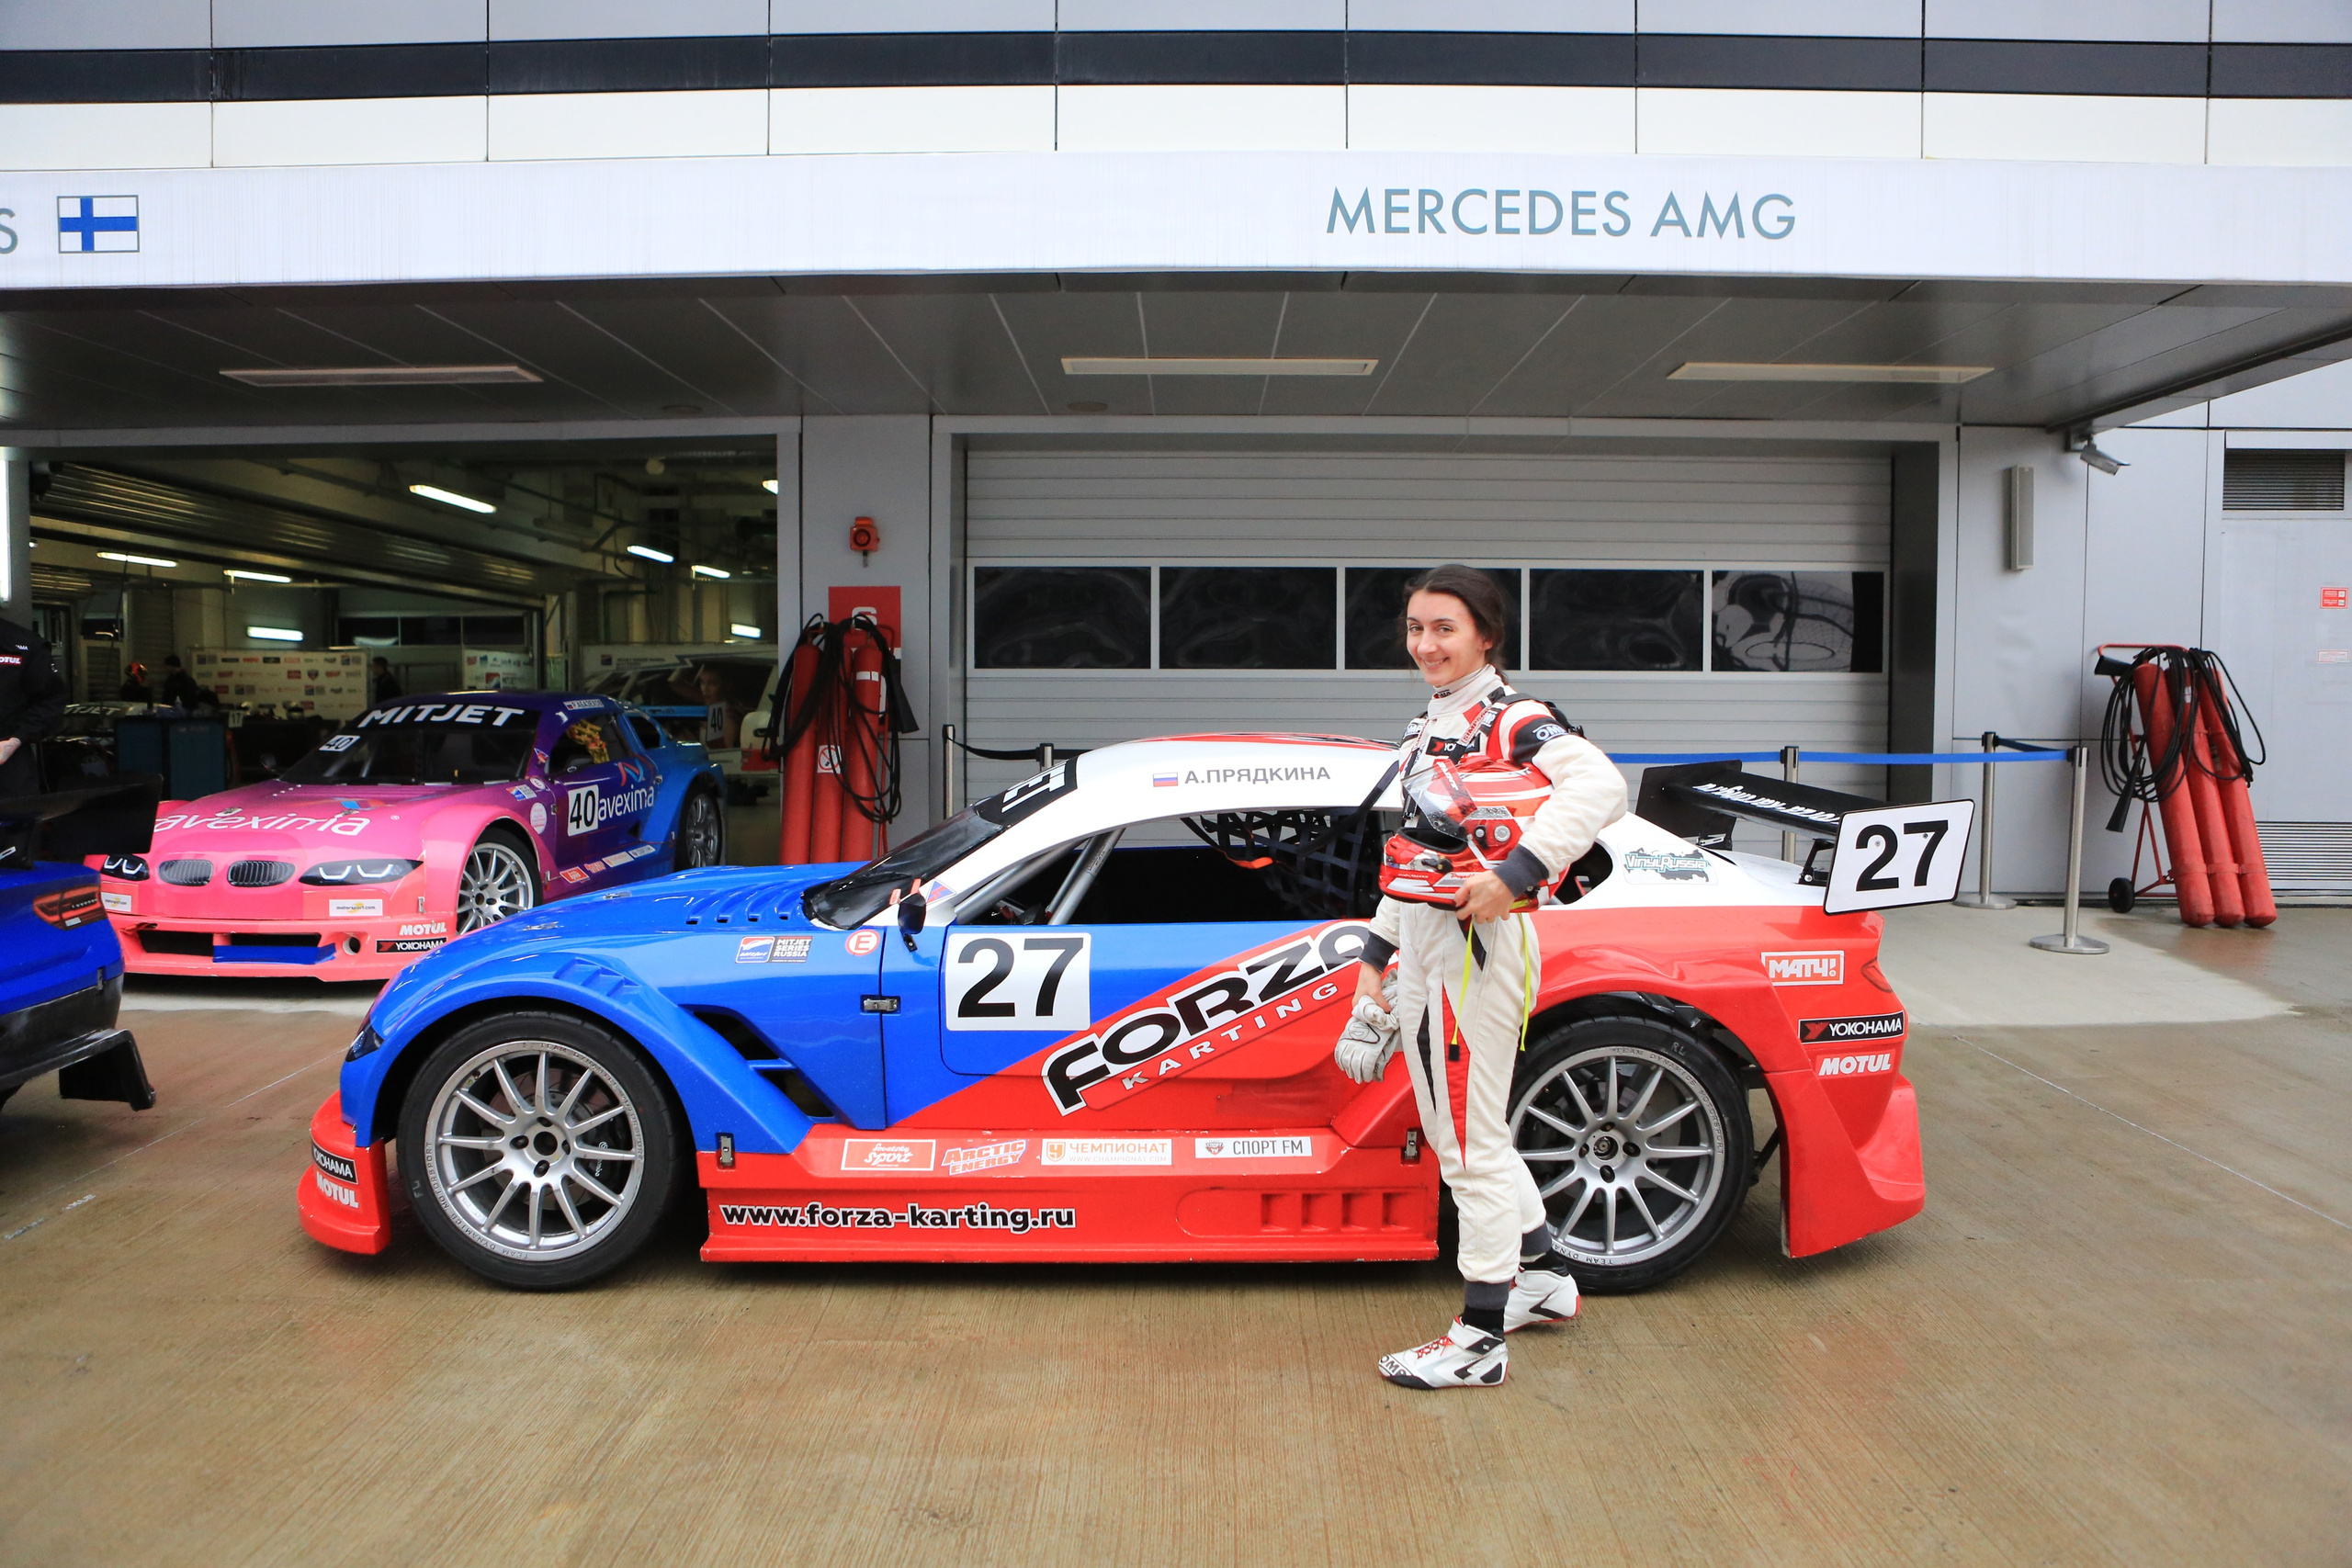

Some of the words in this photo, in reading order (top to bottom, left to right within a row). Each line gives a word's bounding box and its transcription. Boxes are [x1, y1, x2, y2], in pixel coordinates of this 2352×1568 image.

[1326, 186, 1631, 238] MERCEDES
[1649, 190, 1796, 241] AMG
[0, 656, 21, 664] OTUL
[357, 703, 526, 728] MITJET
[711, 706, 723, 733] 40
[325, 735, 356, 751] 40
[1184, 766, 1331, 785] А.ПРЯДКИНА
[570, 789, 596, 829] 40
[598, 784, 655, 822] avexima
[153, 812, 372, 837] avexima
[1855, 819, 1949, 893] 27
[399, 921, 447, 936] MOTUL
[956, 937, 1084, 1019] 27
[1121, 982, 1339, 1091] KARTING
[1829, 1017, 1903, 1037] YOKOHAMA
[1818, 1053, 1892, 1077] MOTUL
[942, 1140, 1026, 1166] ARCTIC
[1069, 1142, 1168, 1154] ЧЕМПИОНАТ
[1233, 1140, 1277, 1156] СПОРТ
[1283, 1139, 1304, 1155] FM
[949, 1152, 1023, 1175] ENERGY
[316, 1171, 359, 1209] MOTUL
[720, 1201, 1077, 1234] www.forza-karting.ru
